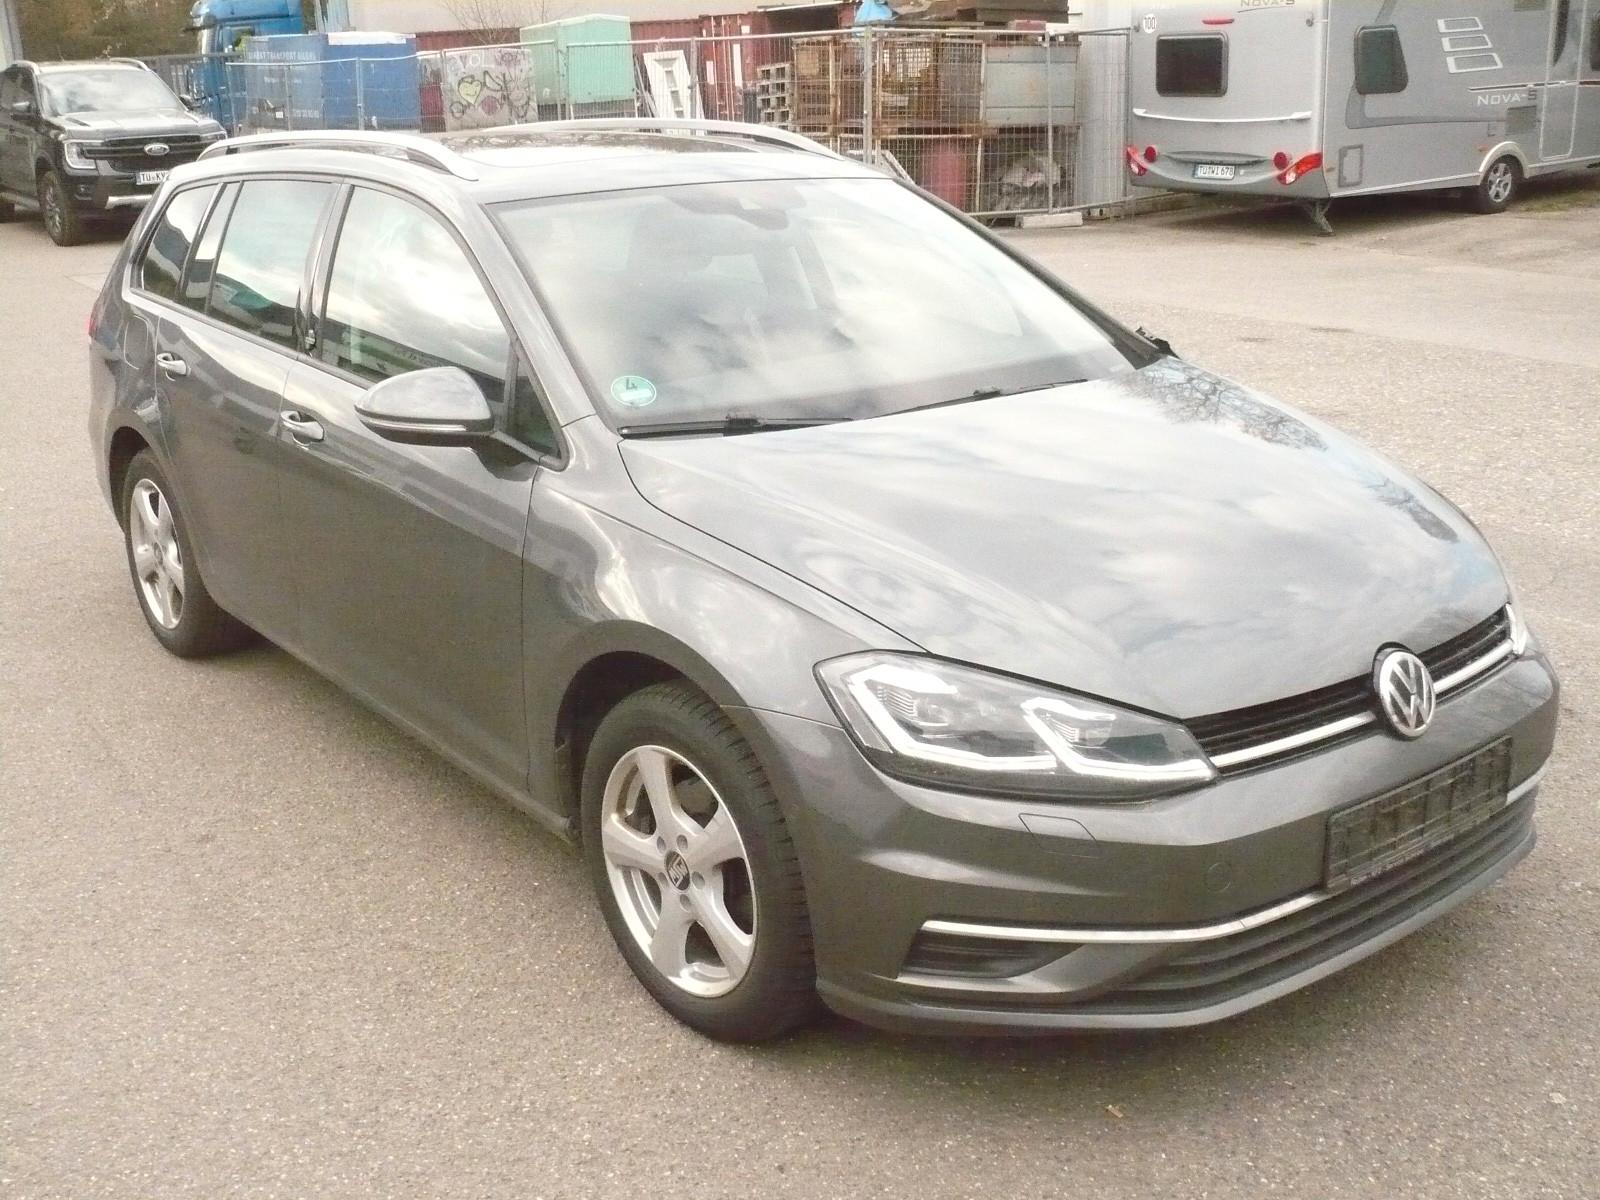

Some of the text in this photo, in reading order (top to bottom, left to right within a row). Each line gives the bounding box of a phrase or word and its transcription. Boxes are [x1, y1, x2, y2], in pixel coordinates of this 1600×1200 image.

[1144, 16, 1156, 30] 100
[1477, 89, 1537, 106] NOVA-S
[626, 378, 638, 391] 4
